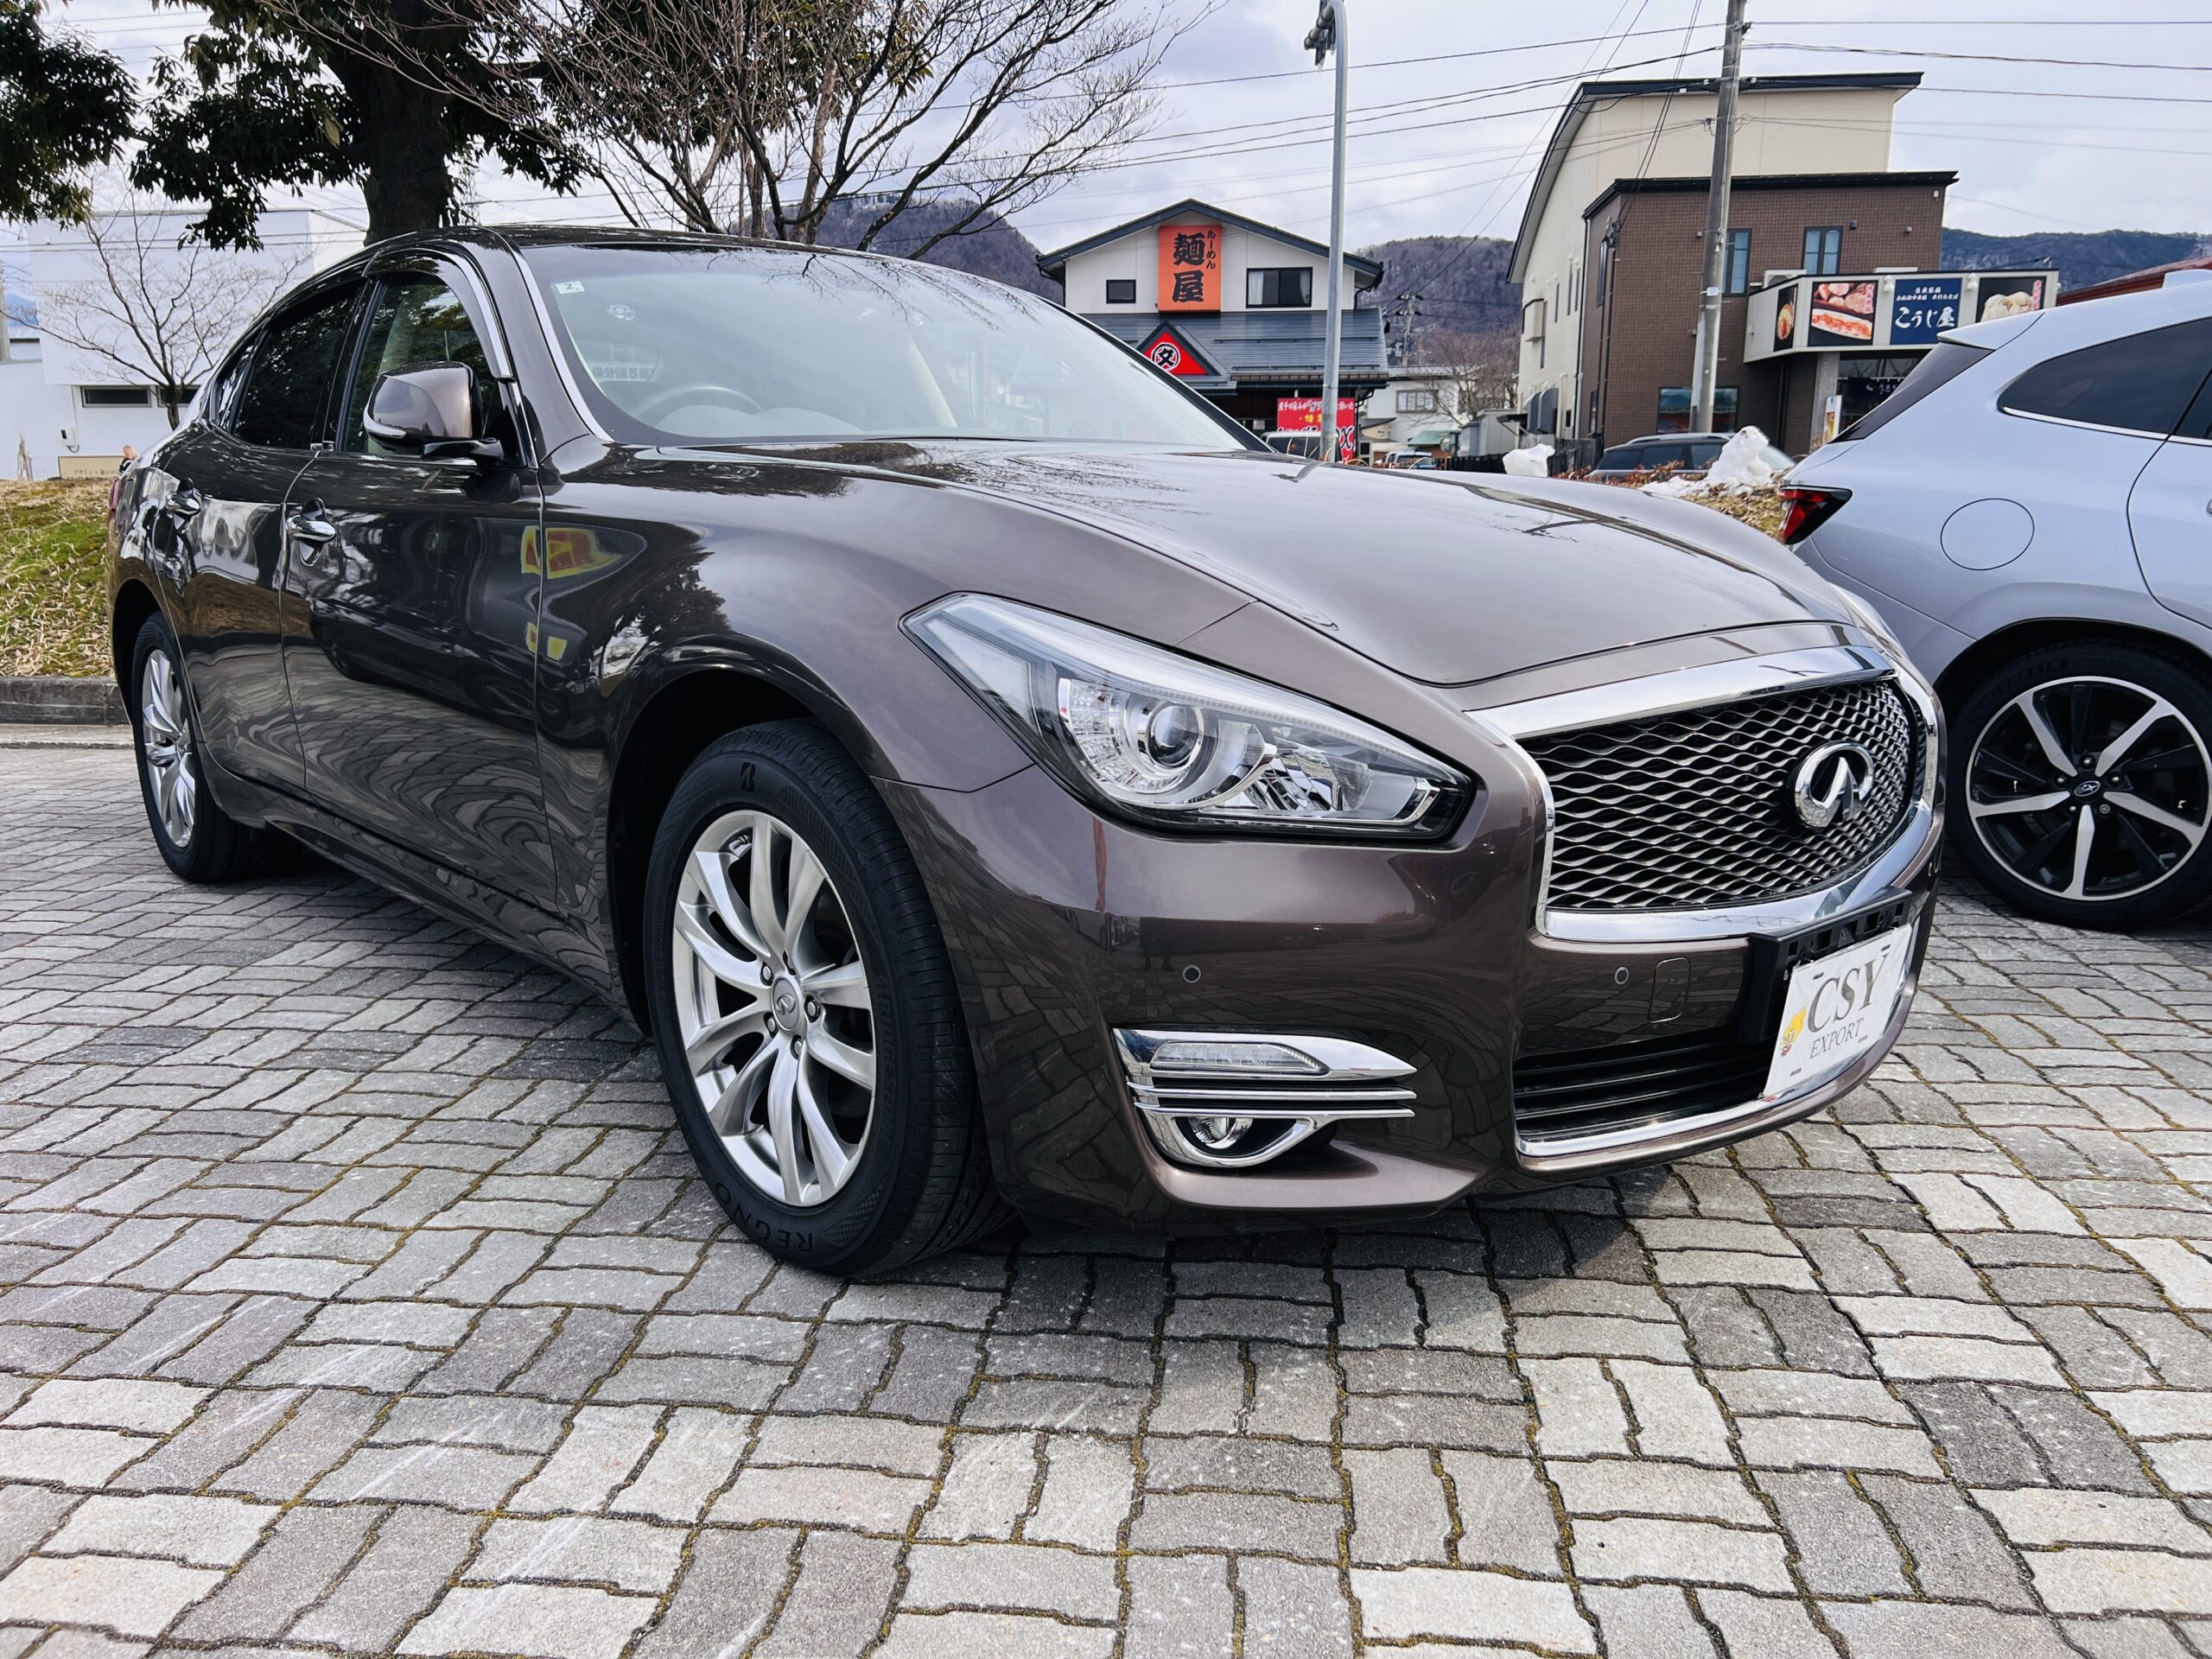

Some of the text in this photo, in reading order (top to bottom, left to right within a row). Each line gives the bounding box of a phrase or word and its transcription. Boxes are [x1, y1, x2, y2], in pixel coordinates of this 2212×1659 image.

[1172, 232, 1205, 303] 麺屋
[1205, 230, 1217, 270] らーめん
[1895, 306, 1955, 329] こうじ屋
[1808, 952, 1890, 1033] CSY
[1809, 1017, 1865, 1059] EXPORT
[715, 1181, 814, 1253] REGNO
